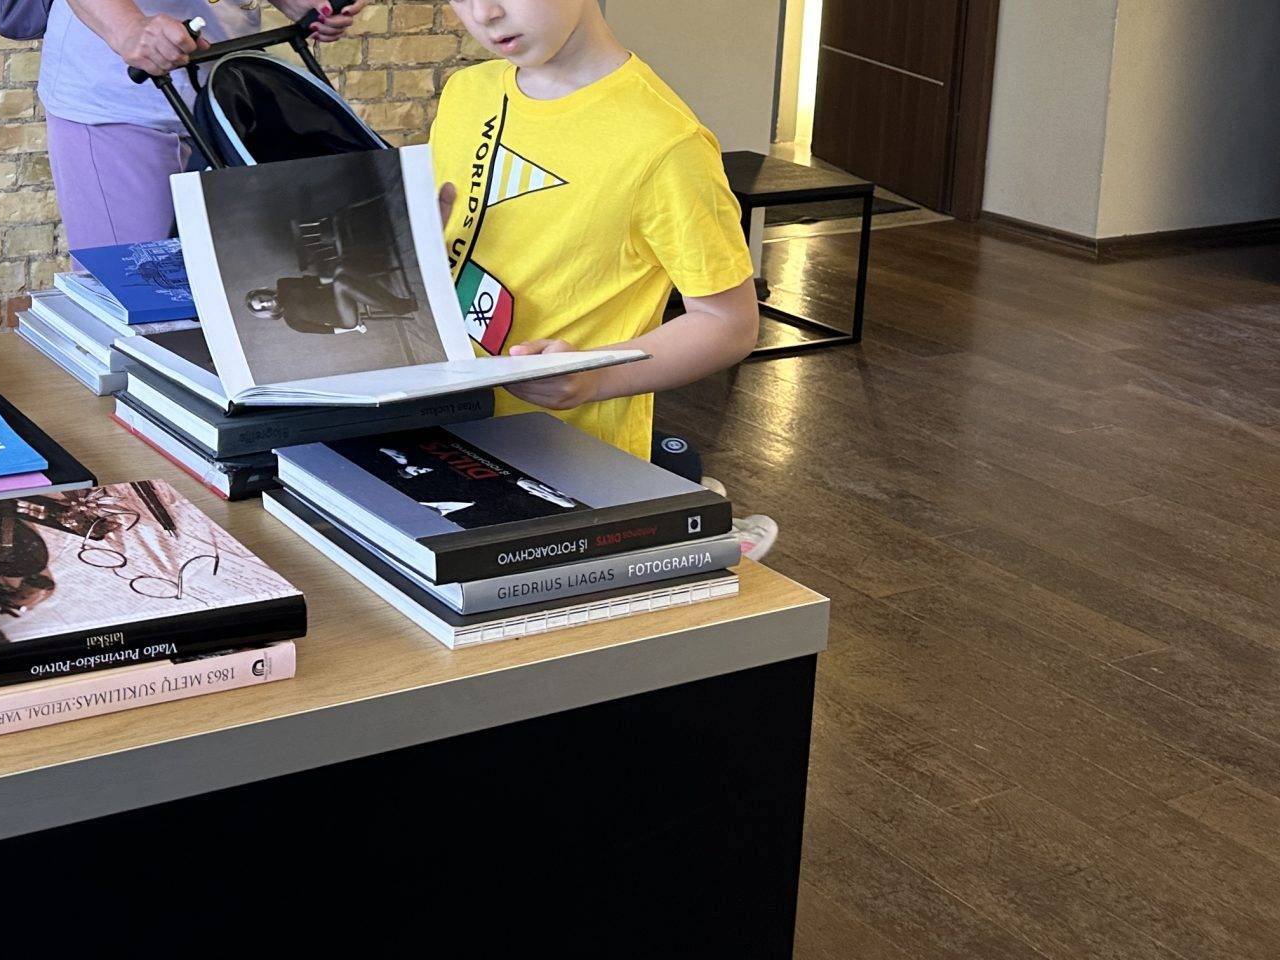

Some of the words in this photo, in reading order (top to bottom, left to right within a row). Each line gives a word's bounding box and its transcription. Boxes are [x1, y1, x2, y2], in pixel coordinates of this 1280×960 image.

[463, 114, 498, 229] WORLDS
[497, 541, 577, 565] FOTOARCHYVO
[579, 539, 588, 554] IŠ
[497, 577, 563, 600] GIEDRIUS
[568, 568, 615, 588] LIAGAS
[628, 552, 712, 578] FOTOGRAFIJA
[86, 631, 124, 650] laiškai
[143, 642, 178, 657] Vlado
[162, 672, 203, 692] METŲ
[207, 666, 236, 685] 1863
